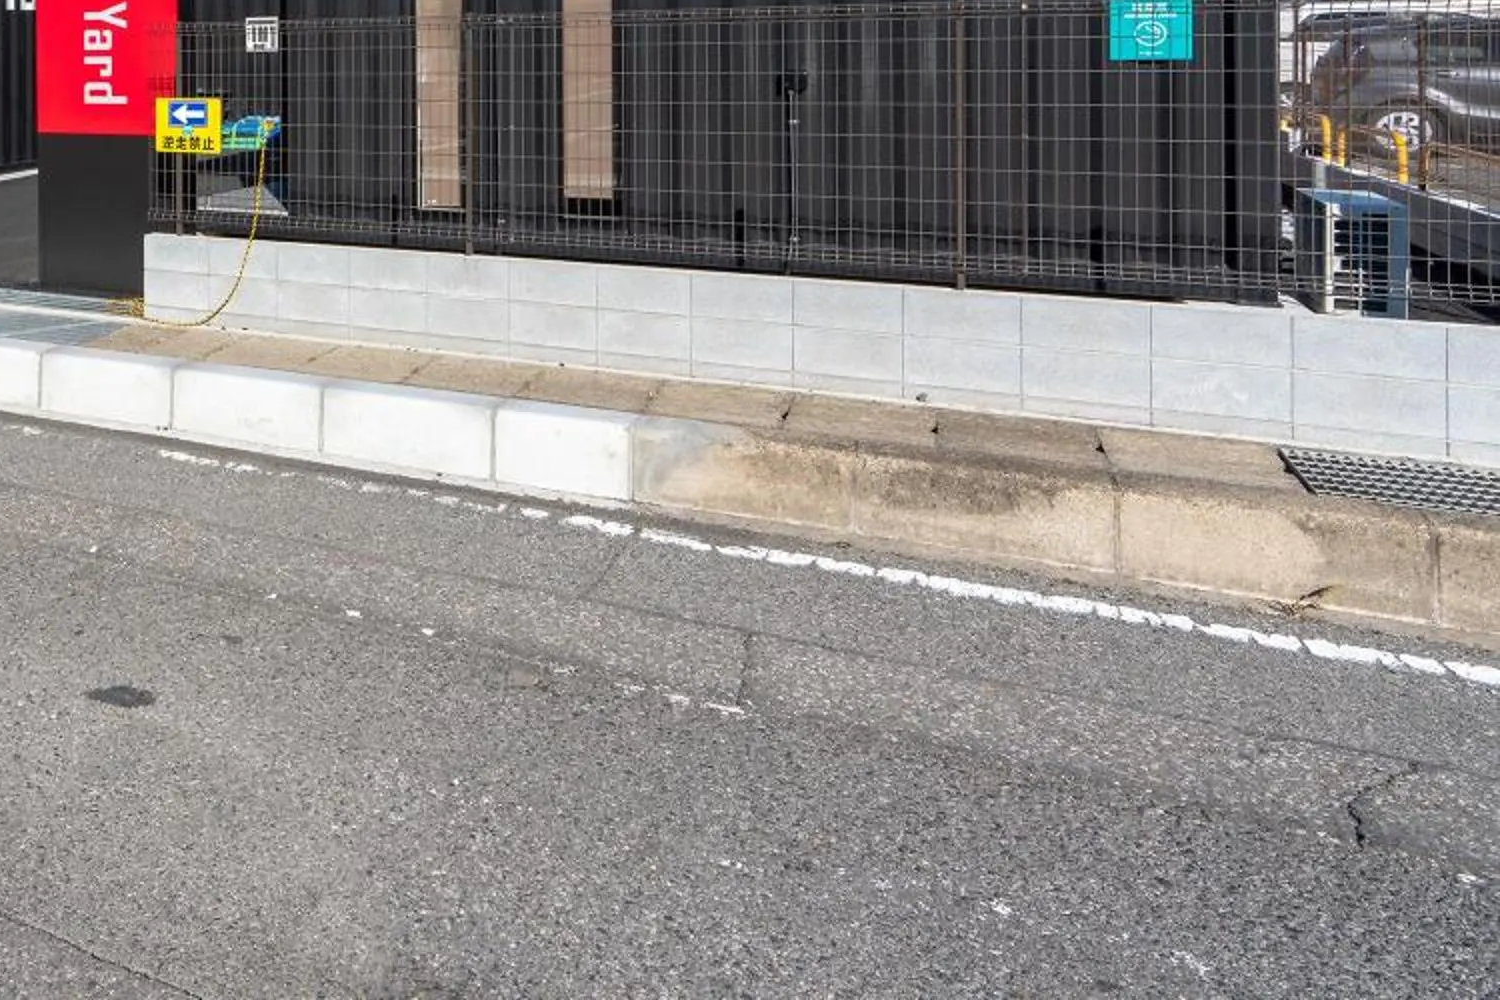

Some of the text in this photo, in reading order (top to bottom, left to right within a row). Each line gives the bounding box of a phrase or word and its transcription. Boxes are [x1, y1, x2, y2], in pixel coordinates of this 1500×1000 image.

[82, 1, 128, 105] Yard
[162, 134, 216, 152] 逆走禁止
